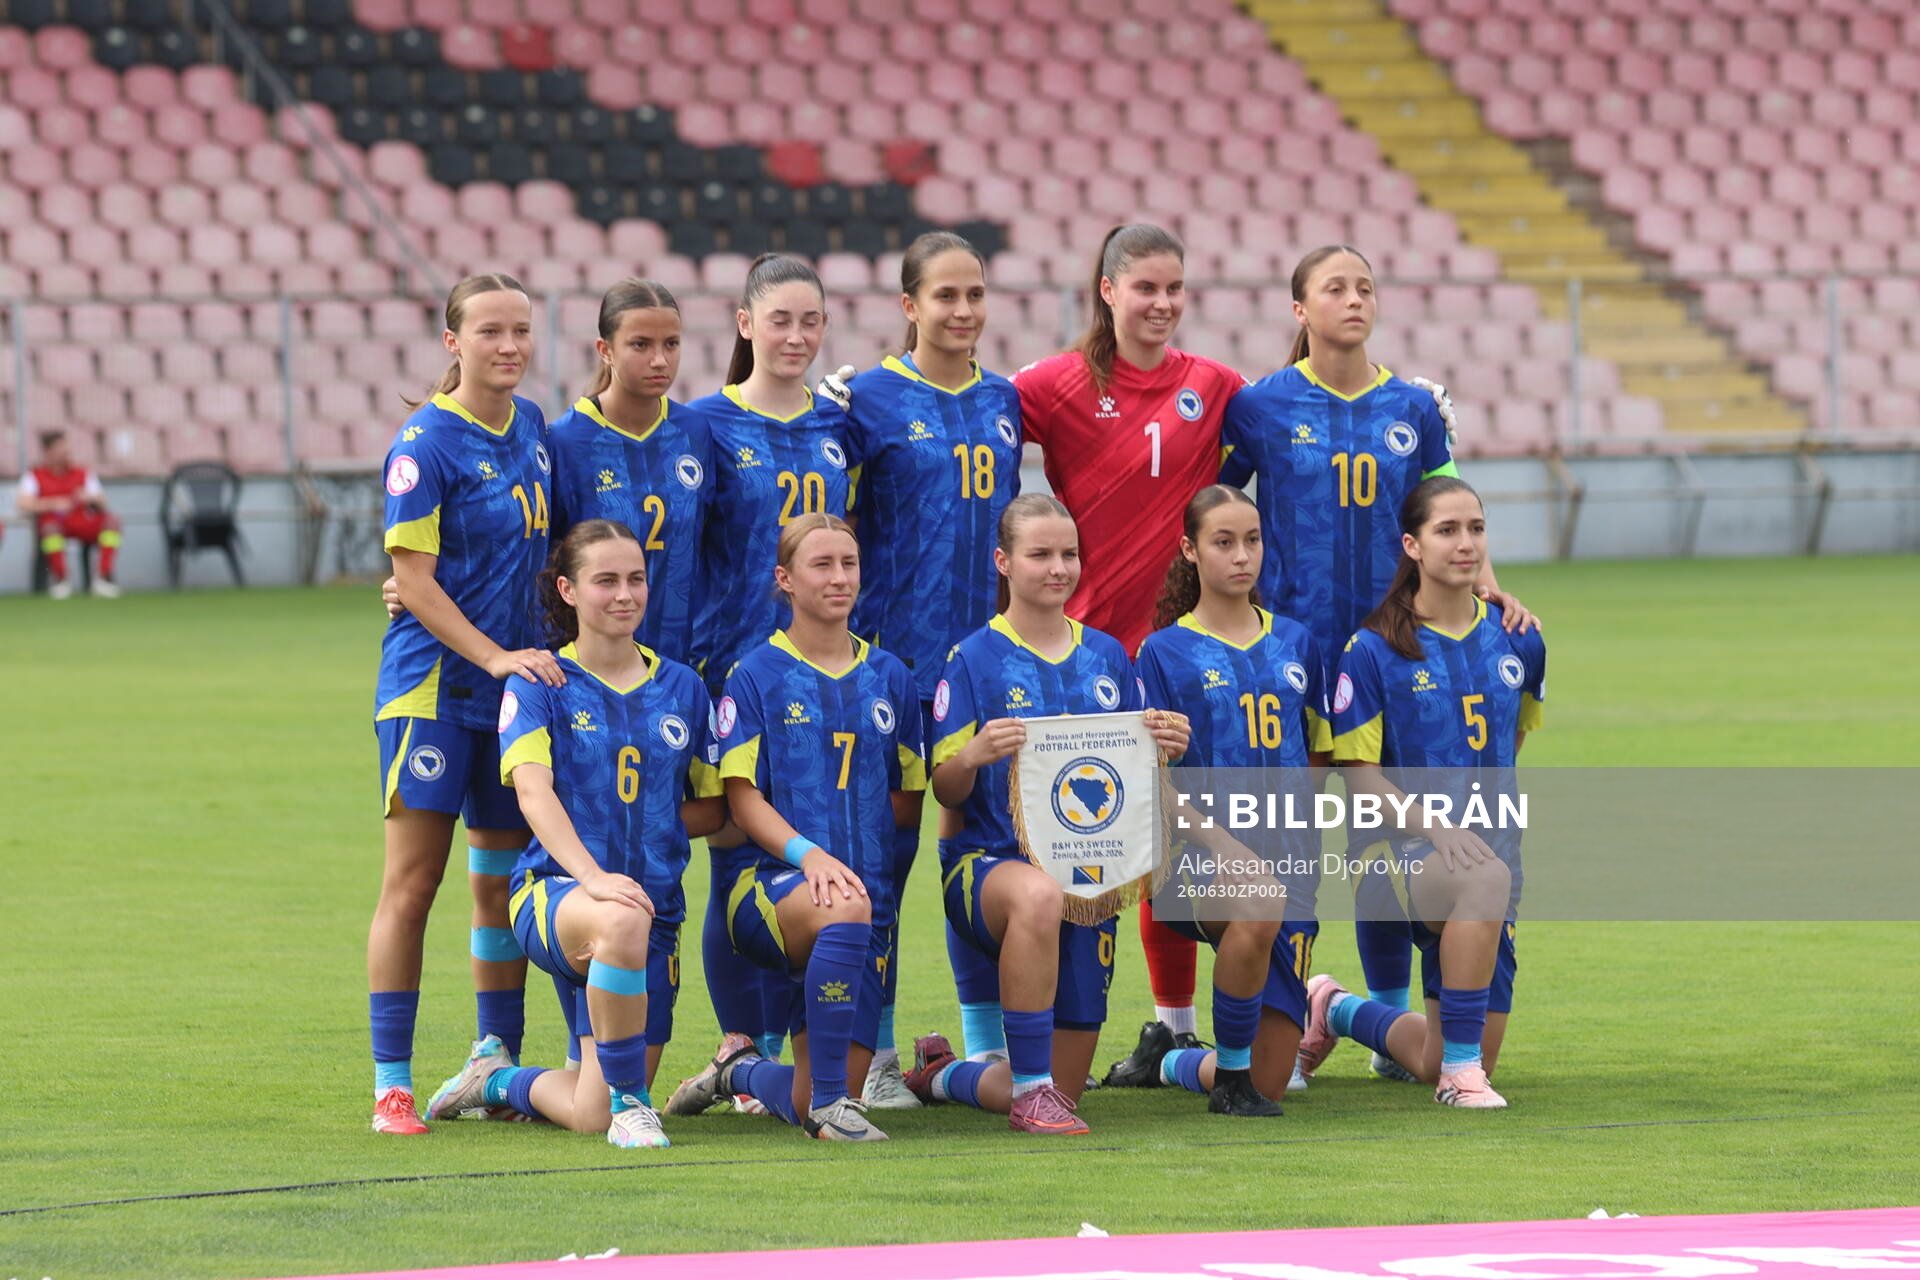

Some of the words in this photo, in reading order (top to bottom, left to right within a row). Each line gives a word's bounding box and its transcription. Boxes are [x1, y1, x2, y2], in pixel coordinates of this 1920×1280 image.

[908, 432, 934, 441] KELME
[1144, 421, 1161, 477] 1
[736, 460, 762, 471] KELME
[953, 443, 995, 499] 18
[596, 481, 623, 493] KELME
[1331, 452, 1377, 508] 10
[777, 471, 825, 527] 20
[512, 481, 549, 539] 14
[644, 495, 665, 551] 2
[1203, 679, 1229, 690] KELME
[1412, 683, 1438, 693] KELME
[1006, 701, 1032, 709] KELME
[571, 722, 597, 732] KELME
[783, 715, 811, 725] KELME
[1239, 692, 1282, 750] 16
[1462, 693, 1487, 752] 5
[1045, 733, 1069, 741] Bosnia
[1071, 732, 1084, 740] and
[1086, 729, 1129, 740] Herzegovina
[1034, 742, 1080, 753] FOOTBALL
[1082, 737, 1138, 750] FEDERATION
[833, 731, 856, 790] 7
[617, 745, 641, 804] 6
[1051, 841, 1071, 850] B&H
[1073, 840, 1084, 849] VS
[1086, 839, 1124, 849] SWEDEN
